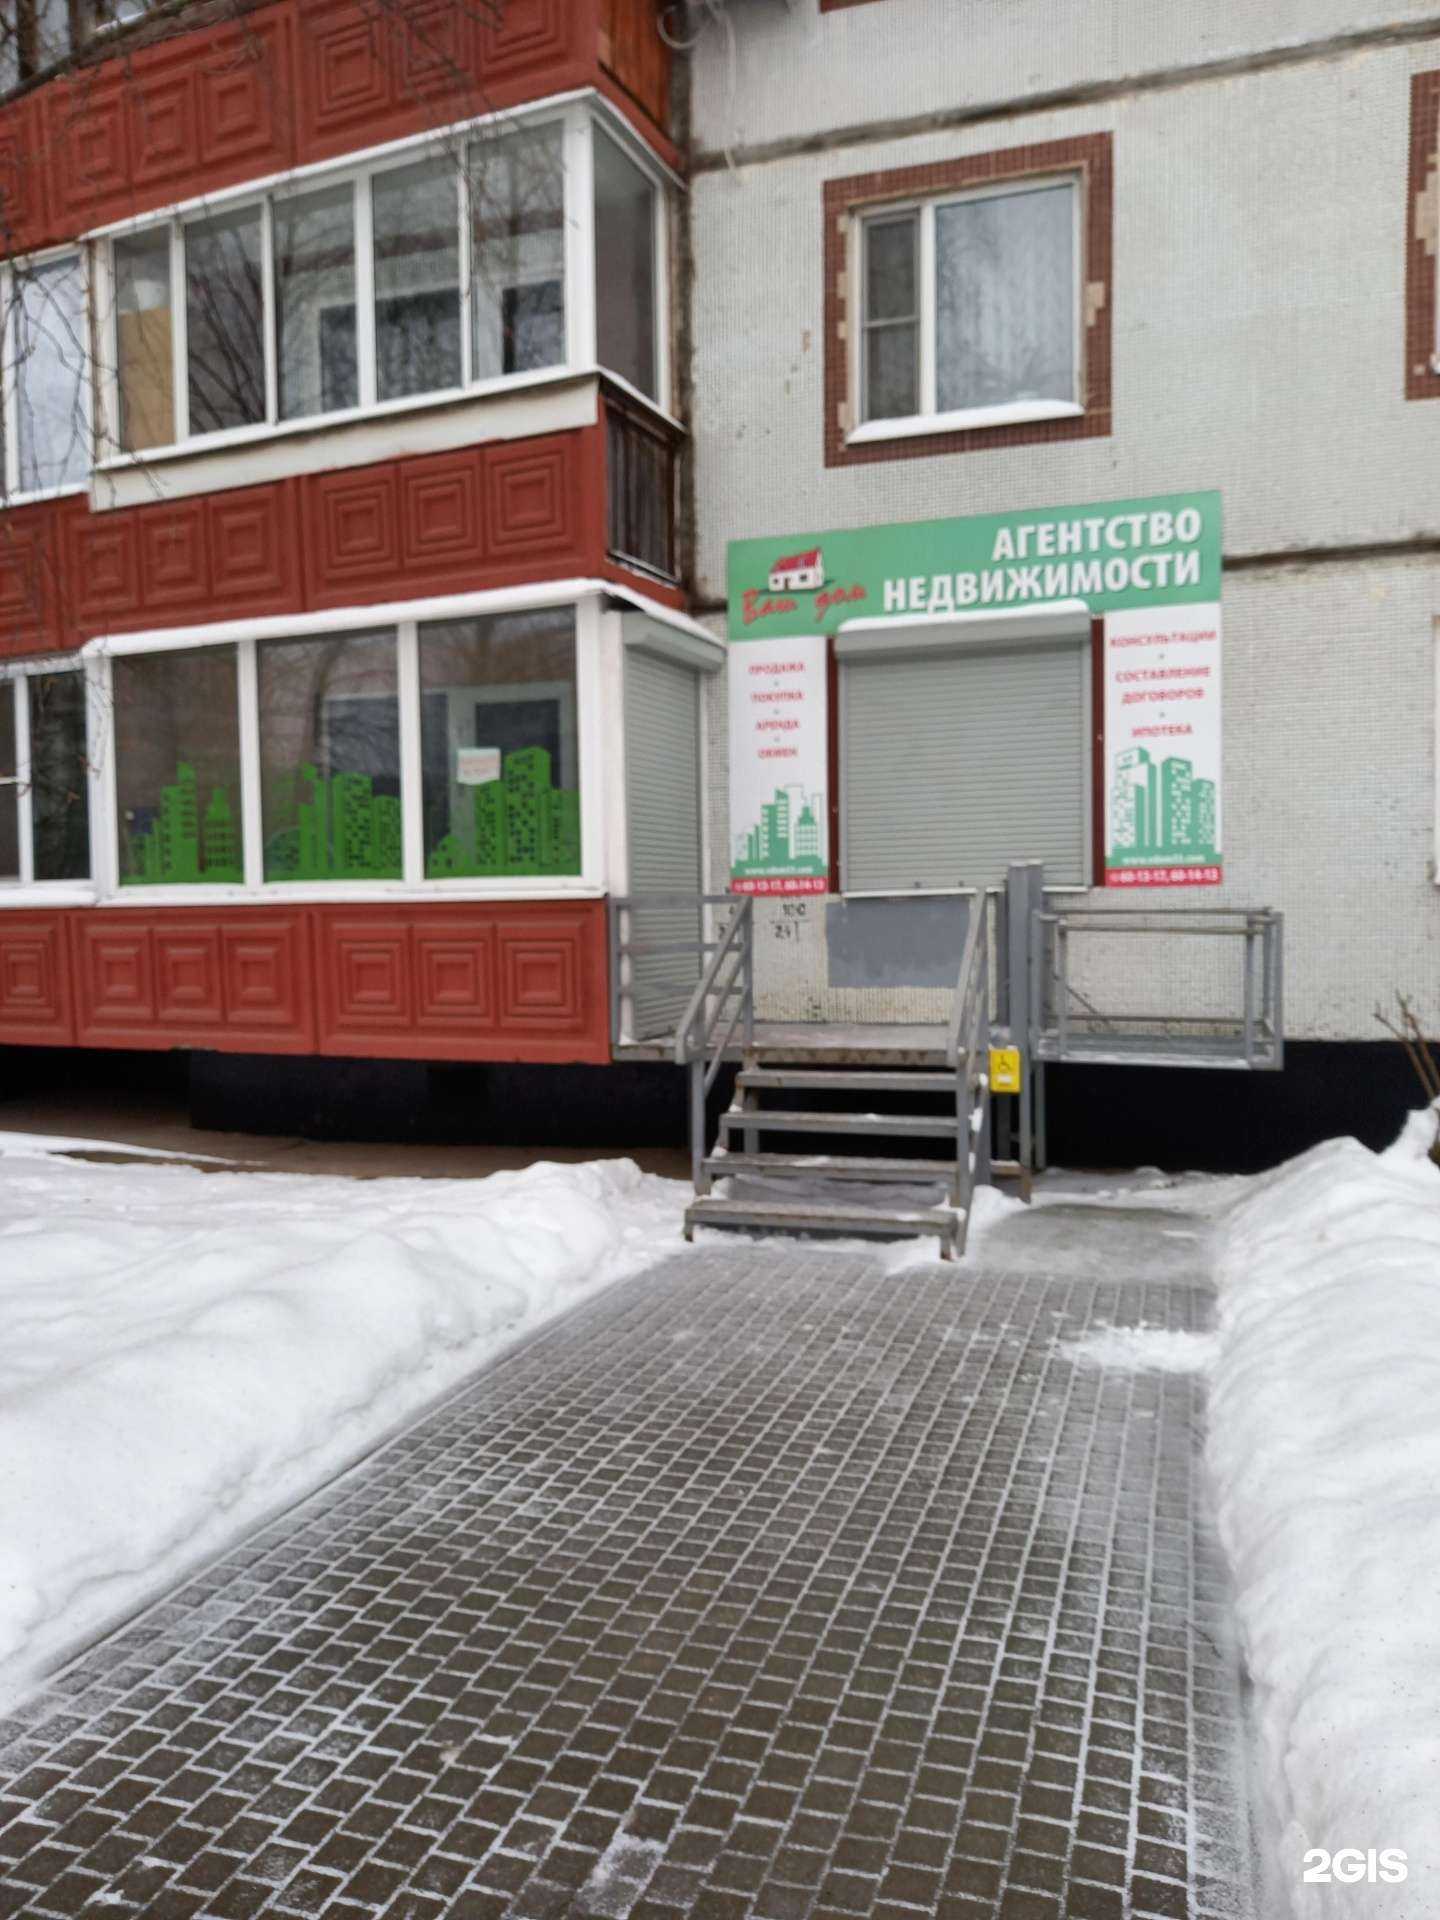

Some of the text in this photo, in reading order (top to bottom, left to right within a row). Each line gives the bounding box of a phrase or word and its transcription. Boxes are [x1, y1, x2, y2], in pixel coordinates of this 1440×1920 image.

[992, 507, 1201, 561] АГЕНТСТВО
[884, 551, 1200, 613] НЕДВИЖИМОСТИ
[1110, 630, 1216, 648] КОНСУЛЬТАЦИИ
[748, 662, 805, 675] ПРОДАЖА
[1115, 666, 1209, 683] СОСТАВЛЕНИЕ
[751, 691, 804, 703] ПОКУПКА
[1122, 687, 1203, 705] ДОГОВОРОВ
[756, 720, 799, 732] АРЕНДА
[1132, 724, 1192, 738] ИПОТЕКА
